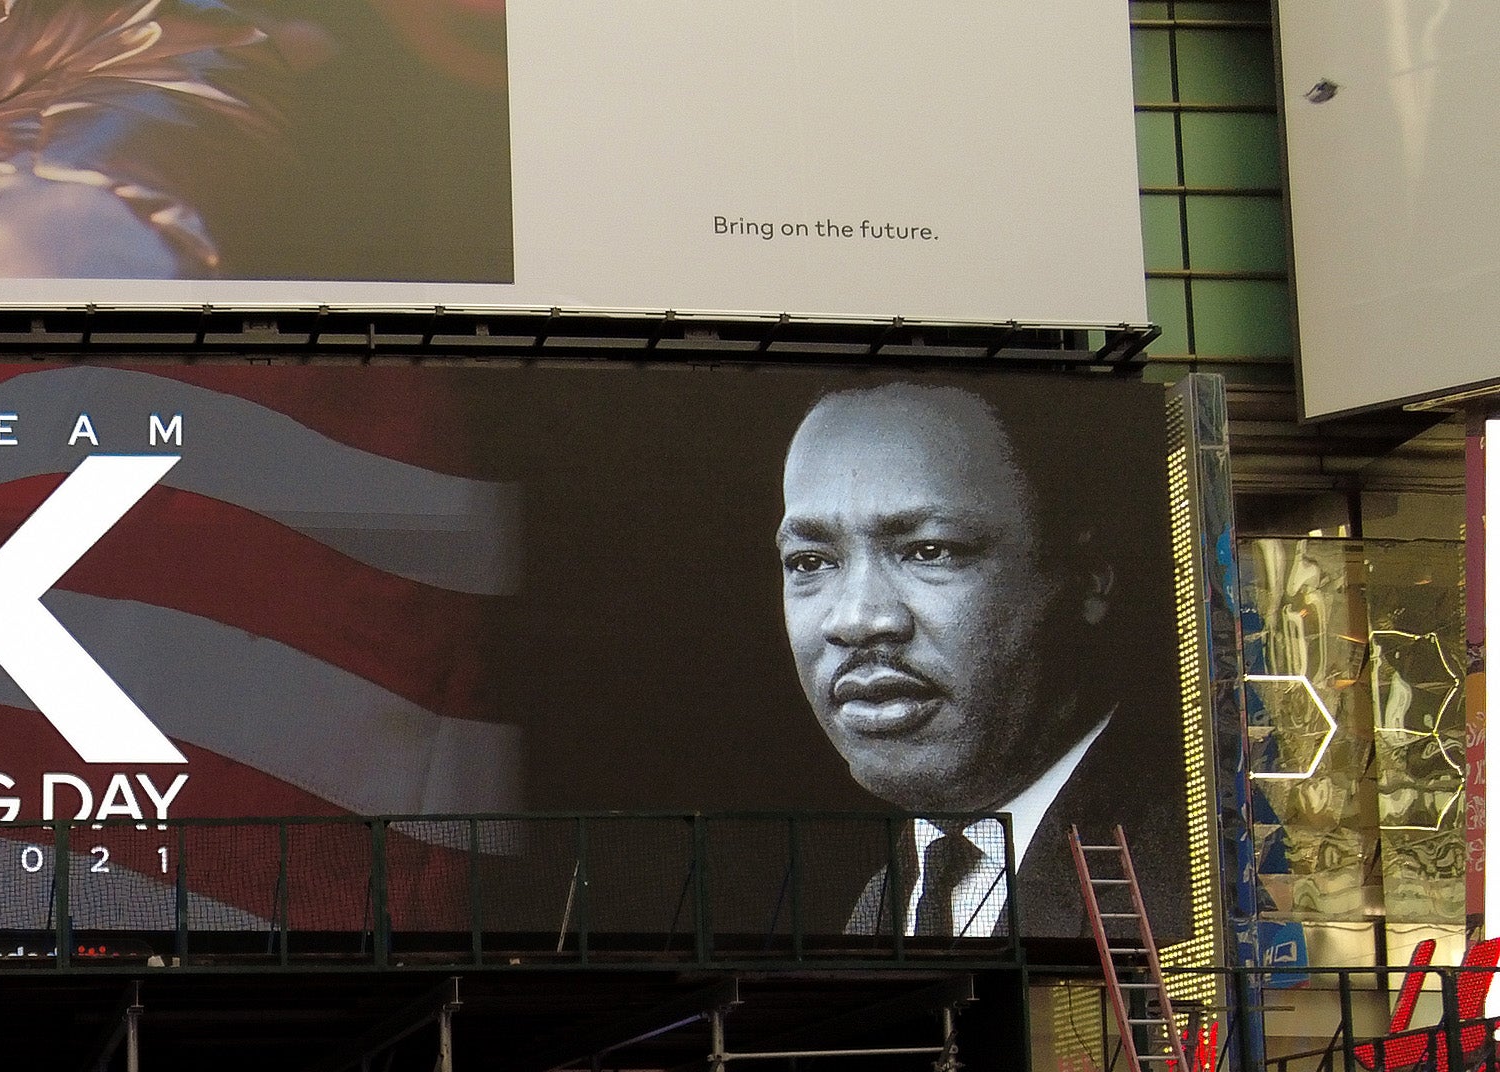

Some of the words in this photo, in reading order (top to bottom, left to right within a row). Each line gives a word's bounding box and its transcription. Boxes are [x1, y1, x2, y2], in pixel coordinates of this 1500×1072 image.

[713, 216, 774, 240] Bring
[781, 222, 809, 237] on
[815, 219, 853, 238] the
[860, 219, 939, 240] future.
[42, 773, 189, 830] DAY
